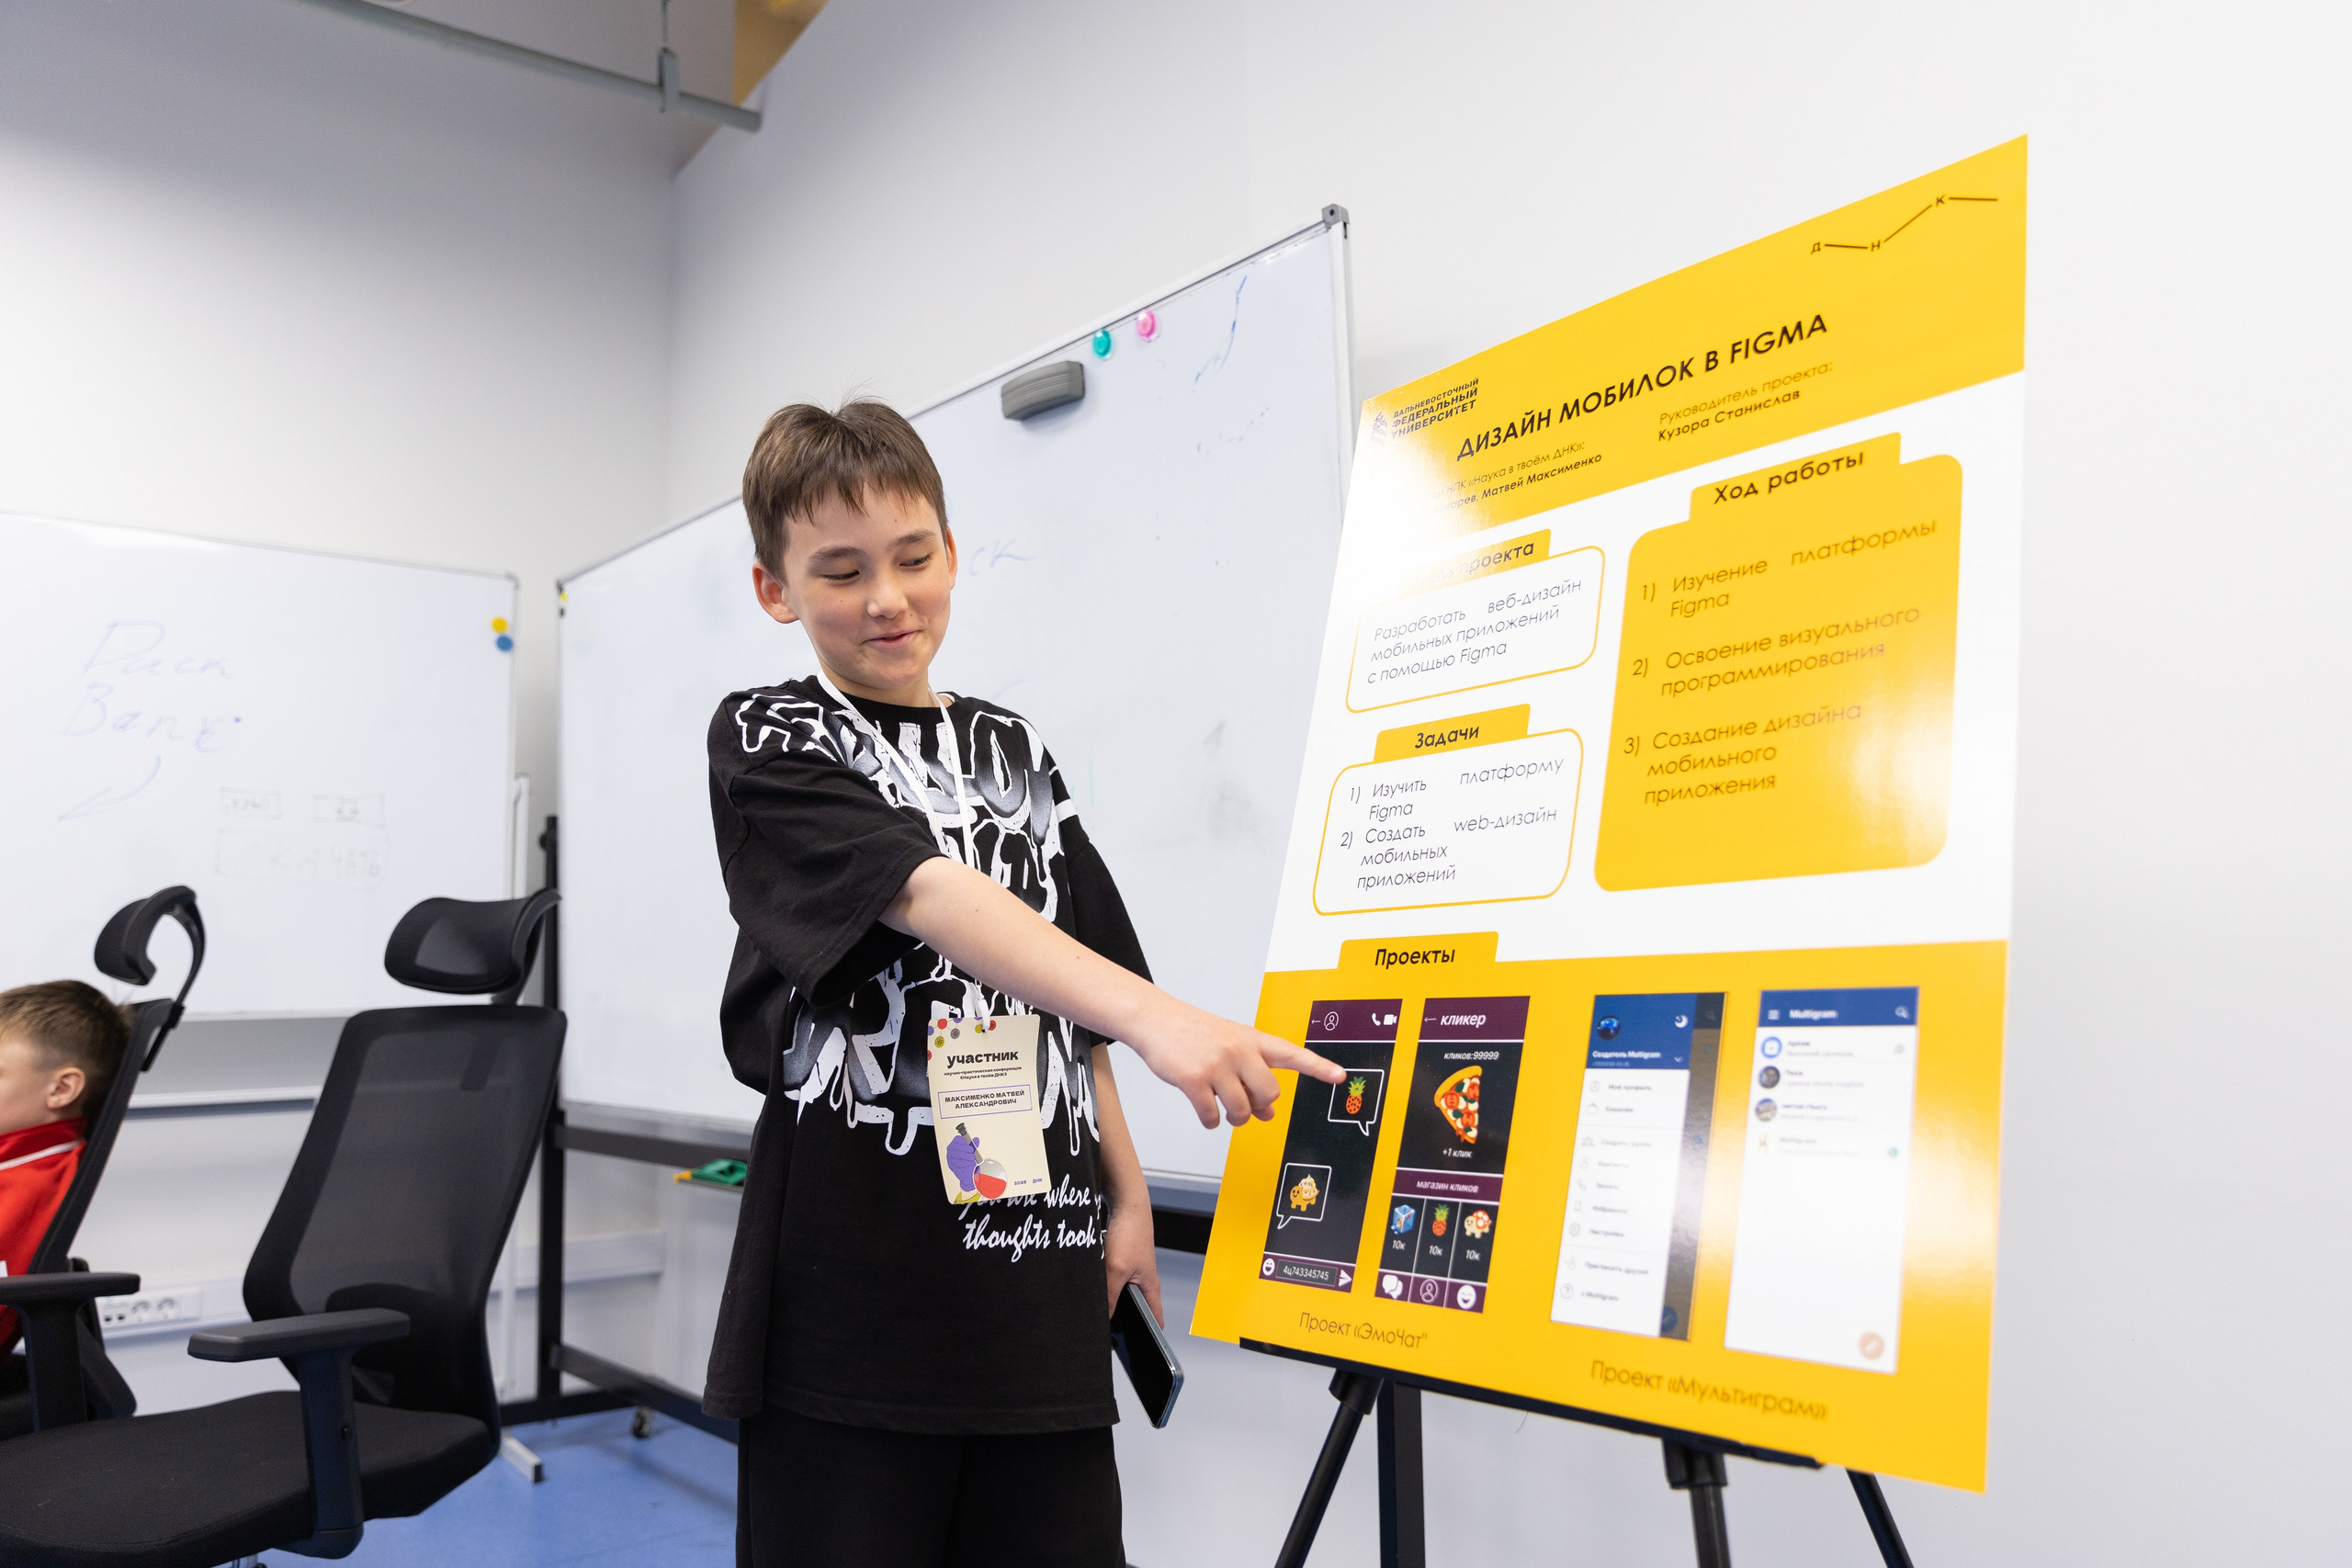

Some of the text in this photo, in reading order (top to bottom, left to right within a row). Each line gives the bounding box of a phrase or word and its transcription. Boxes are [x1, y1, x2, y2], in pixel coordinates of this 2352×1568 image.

[1393, 378, 1479, 418] ДАЛЬНЕВОСТОЧНЫЙ
[1456, 313, 1828, 462] ДИЗАЙН МОБИЛОК В FIGMA
[1658, 361, 1834, 425] Руководитель проекта:
[1391, 399, 1477, 439] УНИВЕРСИТЕТ
[1392, 387, 1478, 429] ФЕДЕРАЛЬНЫЙ
[1658, 389, 1801, 443] Кузора Станислав
[1468, 467, 1507, 488] «Наука
[1517, 453, 1551, 472] твоём
[1553, 442, 1586, 460] ДНК»:
[1481, 478, 1524, 499] Матвей
[1526, 454, 1603, 484] Максименко
[1713, 451, 1865, 505] Ход работы
[1458, 542, 1534, 576] проекта
[1642, 519, 1938, 603] 1) Изучение платформы
[1374, 580, 1582, 641] Разработать веб-дизайн
[1670, 592, 1730, 618] Figma
[1371, 604, 1560, 662] мобильных приложений
[1632, 606, 1921, 678] 2) Освоение визуального
[1367, 642, 1508, 684] с помощью Figma
[1661, 641, 1886, 697] программирования
[1414, 726, 1480, 750] Задачи
[1623, 703, 1862, 757] 3) Создание дизайна
[1646, 743, 1778, 777] мобильного
[1350, 758, 1565, 805] 1) Изучить платформу
[1644, 773, 1777, 807] приложения
[1340, 806, 1557, 850] 2) Создать web-дизайн
[1369, 803, 1413, 822] Figma
[1360, 845, 1448, 866] мобильных
[1357, 863, 1456, 891] приложений
[1374, 948, 1455, 970] Проекты
[1441, 1013, 1487, 1028] кликер
[946, 1051, 1019, 1069] участник
[944, 1089, 1025, 1103] МАКСИМЕНКО МАТВЕЙ
[955, 1098, 1017, 1110] АЛЕКСАНДРОВИЧ
[1453, 1149, 1473, 1158] клик
[1044, 1173, 1091, 1209] where
[1416, 1180, 1479, 1193] магазин кликов
[962, 1213, 1050, 1263] thoughts
[1057, 1215, 1096, 1249] took
[1299, 1312, 1351, 1337] Проект
[1591, 1359, 1828, 1420] Проект «Мультиграм»
